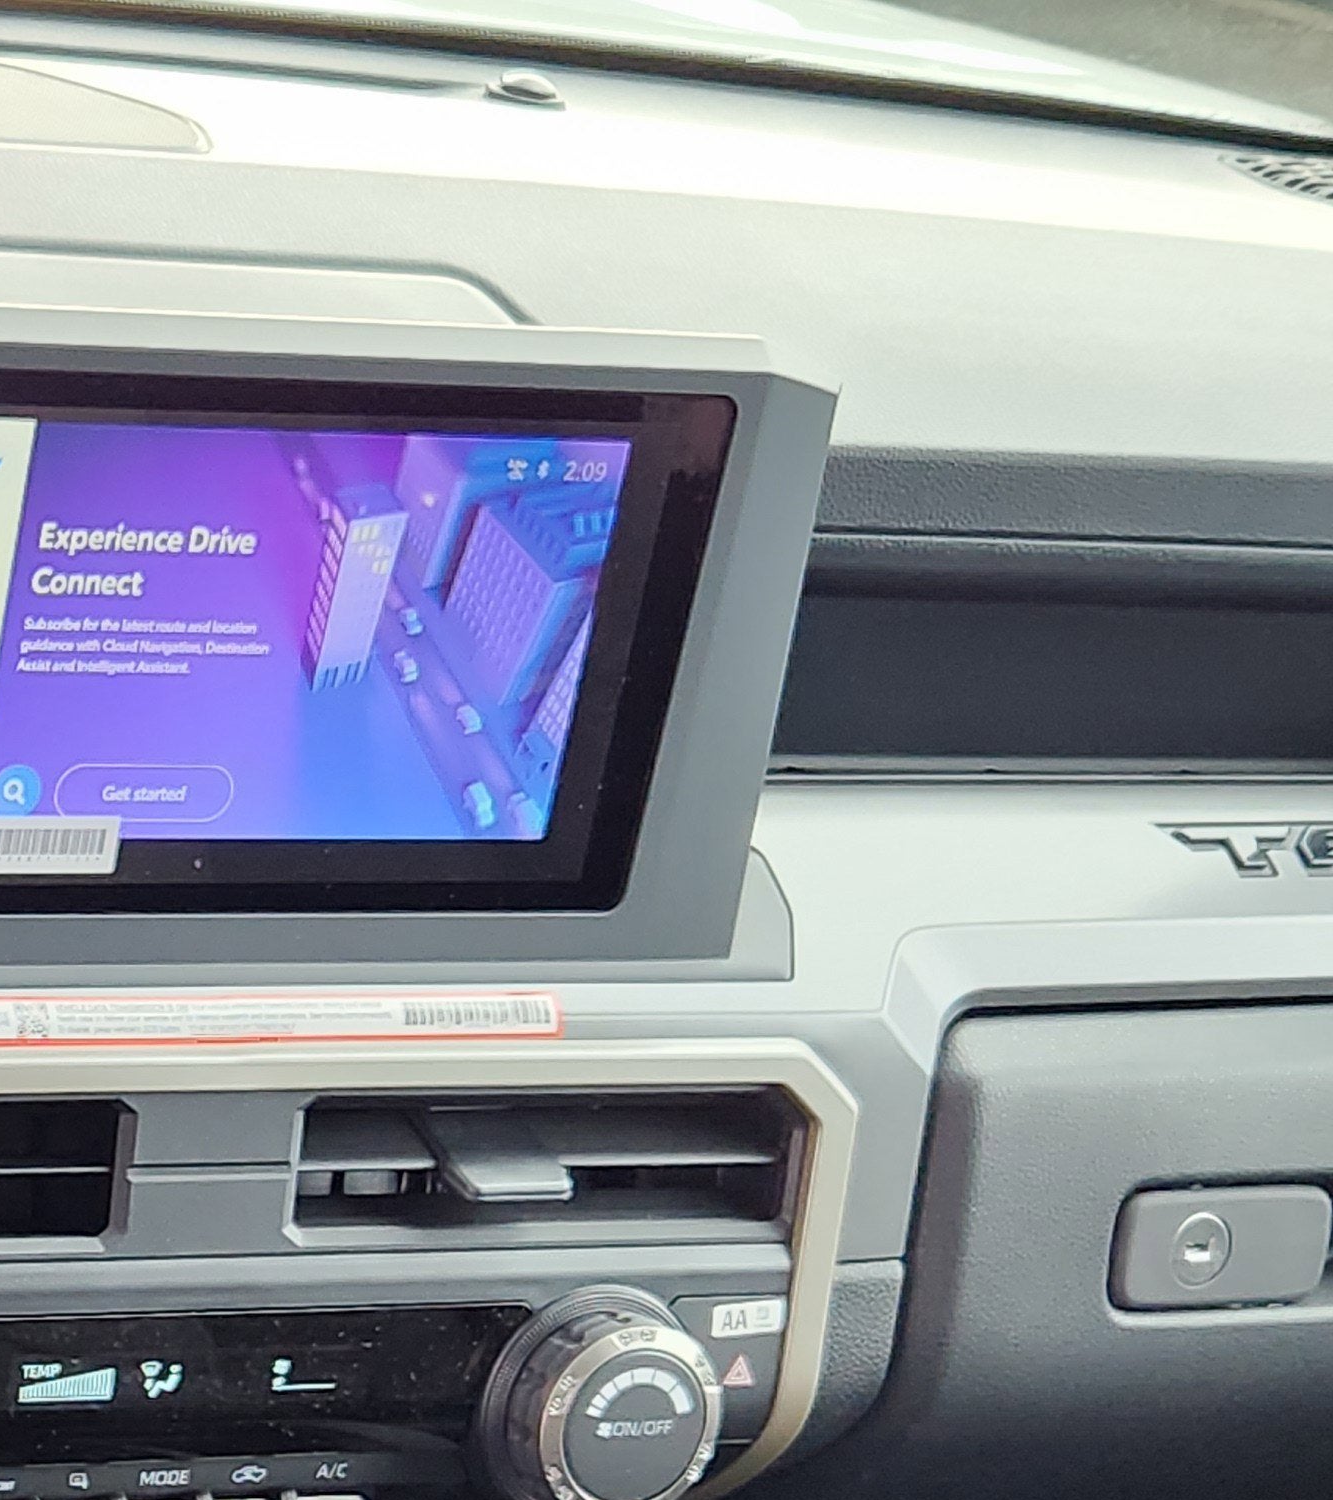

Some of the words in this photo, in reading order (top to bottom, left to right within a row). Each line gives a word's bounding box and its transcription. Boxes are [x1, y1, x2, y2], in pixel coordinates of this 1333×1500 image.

[563, 461, 609, 482] 2:09
[39, 522, 183, 556] Experience
[188, 525, 257, 554] Drive
[32, 567, 145, 596] Connect
[82, 617, 99, 632] for
[100, 618, 120, 632] the
[102, 785, 131, 801] Get
[133, 785, 188, 802] started
[22, 1363, 63, 1379] TEMP
[612, 1418, 673, 1437] ON/OFF
[139, 1468, 190, 1487] MODE
[316, 1462, 348, 1480] A/C
